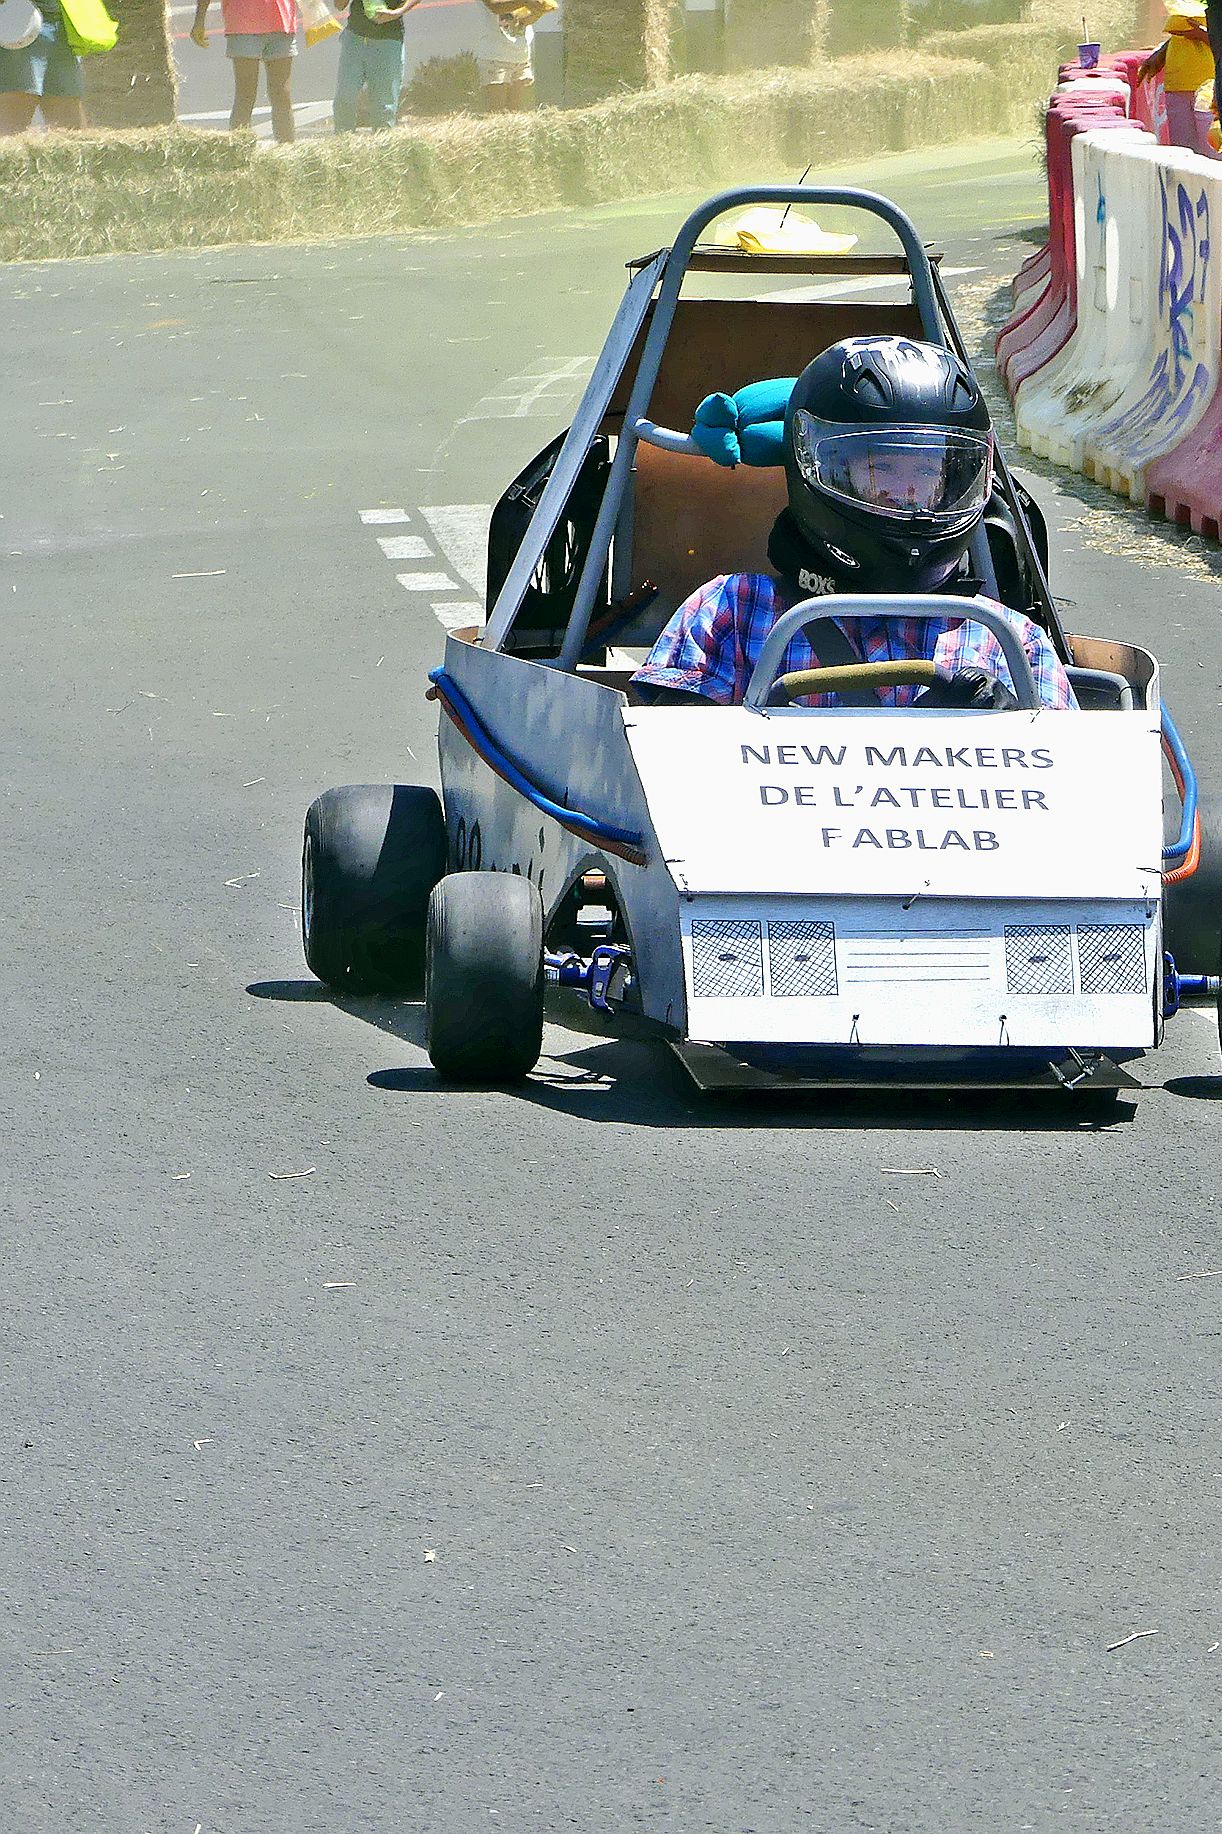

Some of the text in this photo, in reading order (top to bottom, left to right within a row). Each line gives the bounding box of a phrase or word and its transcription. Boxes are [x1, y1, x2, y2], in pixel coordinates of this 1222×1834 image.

[740, 744, 1054, 769] NEW MAKERS
[759, 785, 1049, 811] DE L'ATELIER
